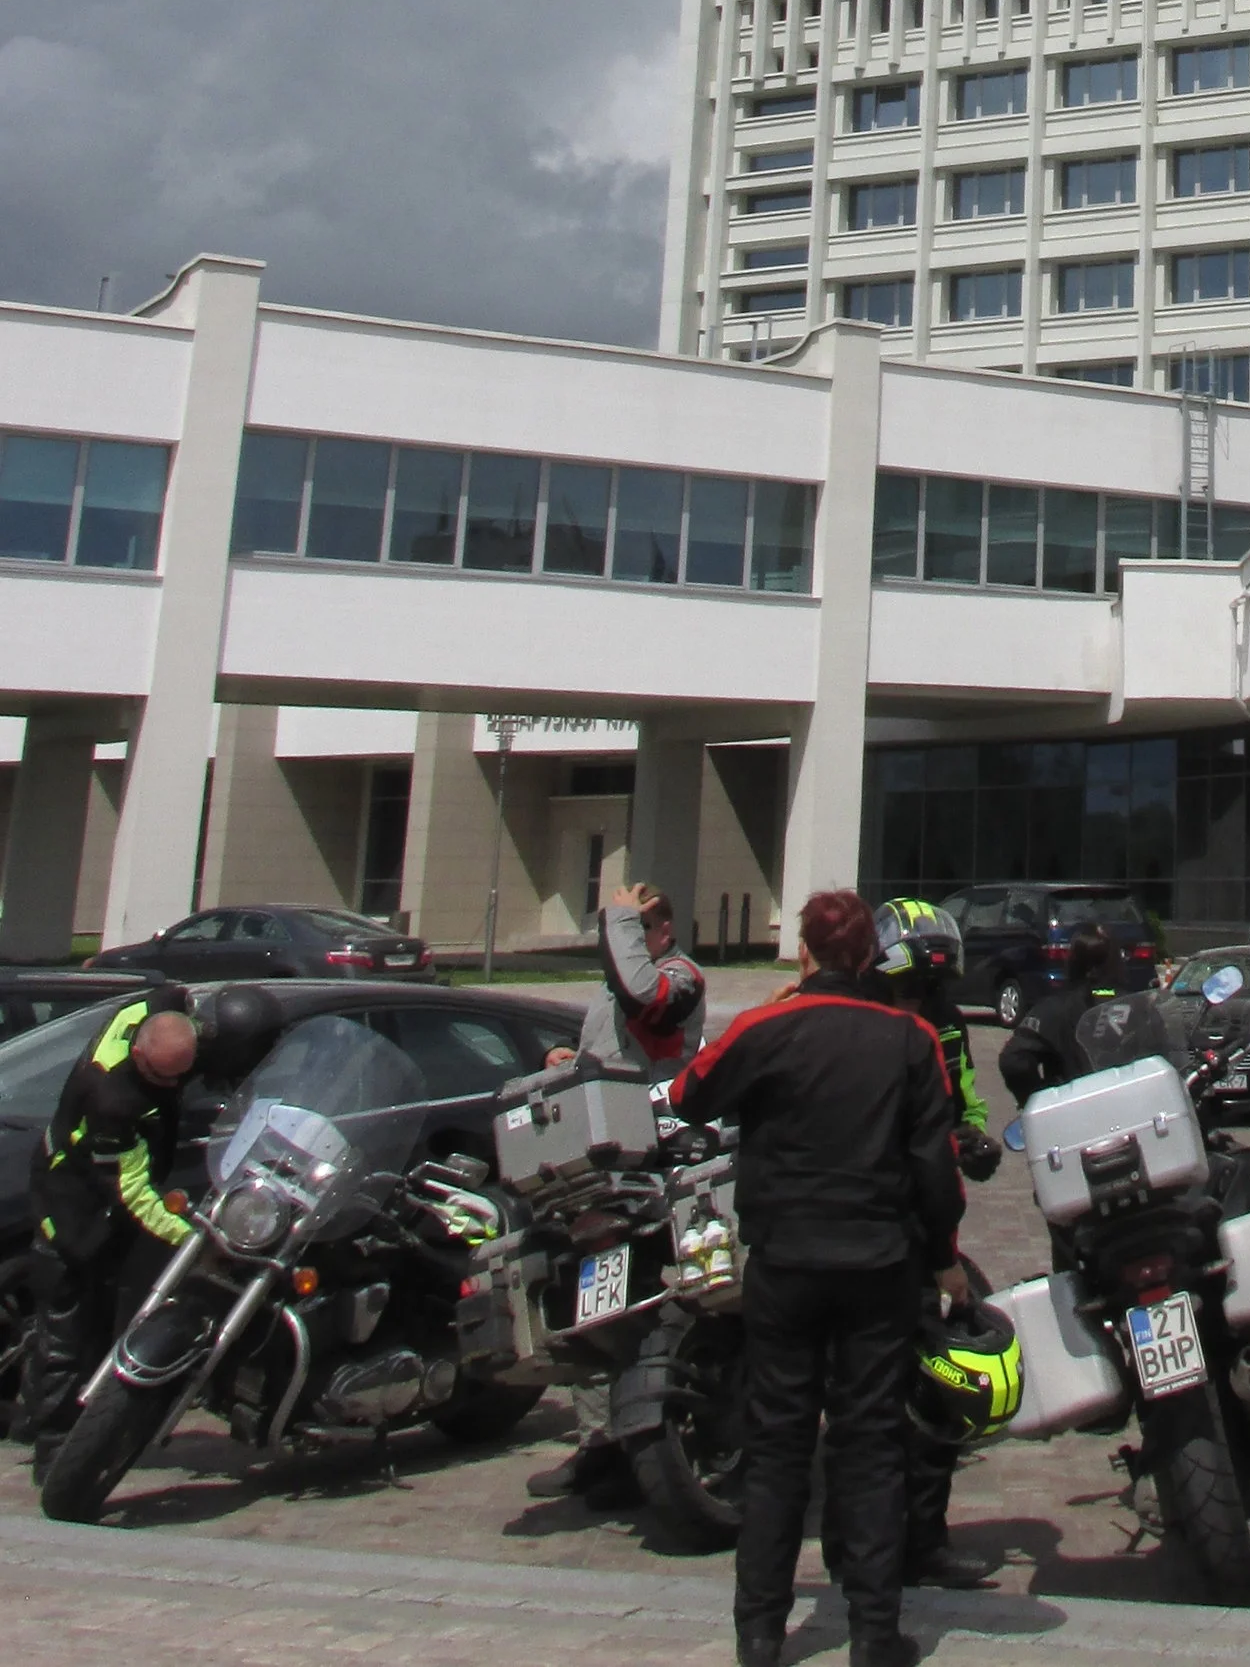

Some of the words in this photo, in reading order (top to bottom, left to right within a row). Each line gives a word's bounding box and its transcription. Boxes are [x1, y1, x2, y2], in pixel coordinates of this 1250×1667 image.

[597, 1252, 624, 1283] 53
[581, 1279, 623, 1317] LFK
[1152, 1300, 1186, 1340] 27
[933, 1358, 963, 1385] SHOEI
[1140, 1335, 1195, 1379] BHP
